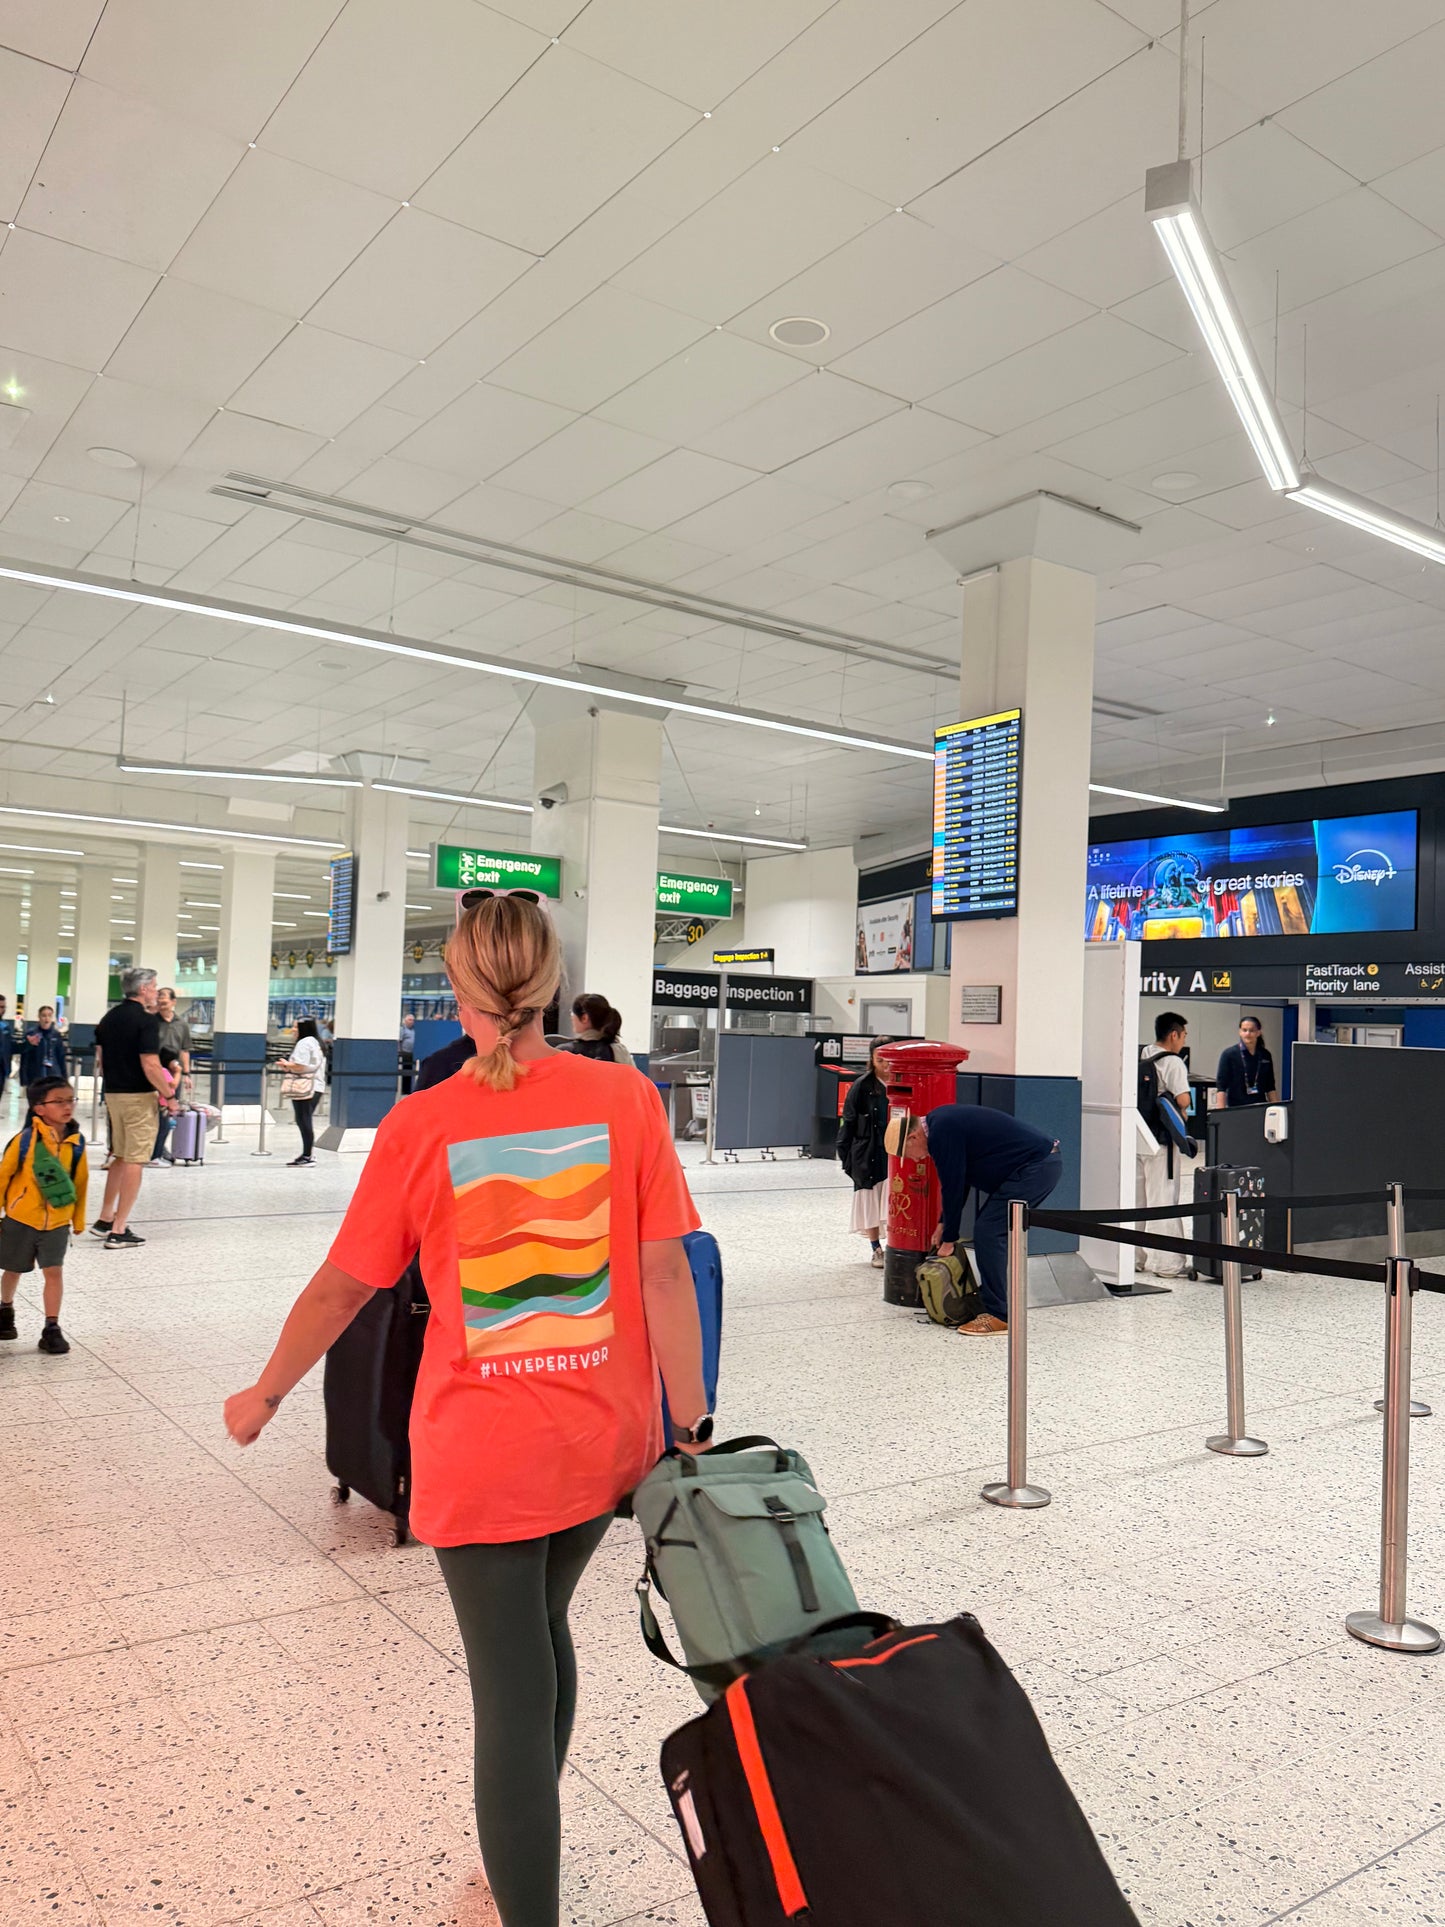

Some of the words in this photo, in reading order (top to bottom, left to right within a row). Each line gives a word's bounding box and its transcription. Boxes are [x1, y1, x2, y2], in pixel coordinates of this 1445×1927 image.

[476, 854, 542, 876] Emergency
[476, 870, 501, 884] exit
[659, 875, 720, 896] Emergency
[1088, 885, 1099, 900] A
[1101, 883, 1143, 900] lifetime
[1197, 876, 1212, 893] of
[1213, 874, 1251, 896] great
[1254, 870, 1304, 889] stories
[659, 891, 681, 904] exit
[687, 924, 705, 943] 30
[1305, 963, 1366, 977] FastTrack
[654, 979, 719, 999] Baggage
[726, 983, 795, 1002] inspection
[798, 988, 806, 1003] 1
[1139, 971, 1181, 997] rity
[1189, 970, 1208, 993] A
[1305, 978, 1349, 994] Priority
[1353, 978, 1381, 992] lane
[480, 1346, 609, 1379] #LIVEPEREVOR
